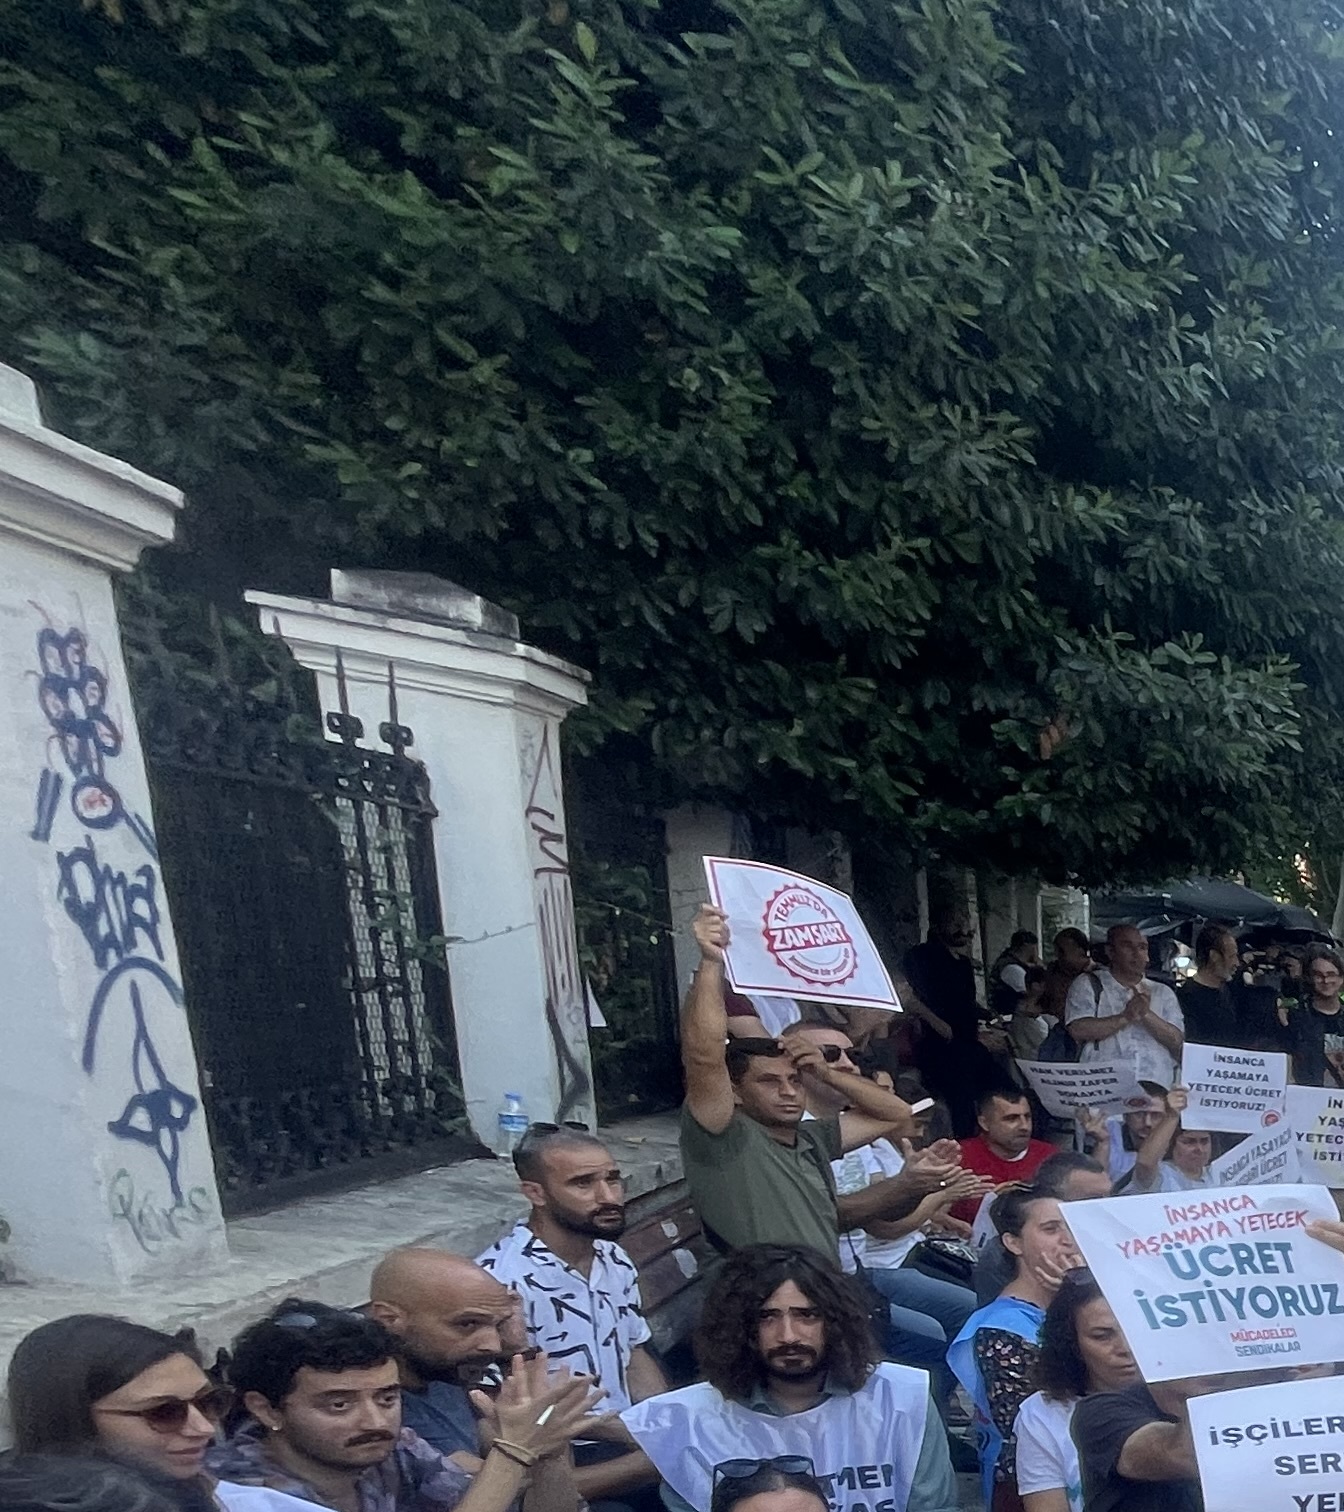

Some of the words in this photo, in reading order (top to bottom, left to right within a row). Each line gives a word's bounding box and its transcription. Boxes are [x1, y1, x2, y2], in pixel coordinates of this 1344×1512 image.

[1213, 1051, 1266, 1067] İNSANCA
[1206, 1068, 1269, 1083] YAŞAMAYA
[1187, 1082, 1242, 1096] YETECEK
[1244, 1084, 1282, 1099] ÜCRET
[1164, 1194, 1257, 1225] İNSANCA
[1117, 1219, 1232, 1259] YAŞAMAYA
[1234, 1210, 1309, 1235] YETECEK
[1164, 1242, 1295, 1280] ÜCRET
